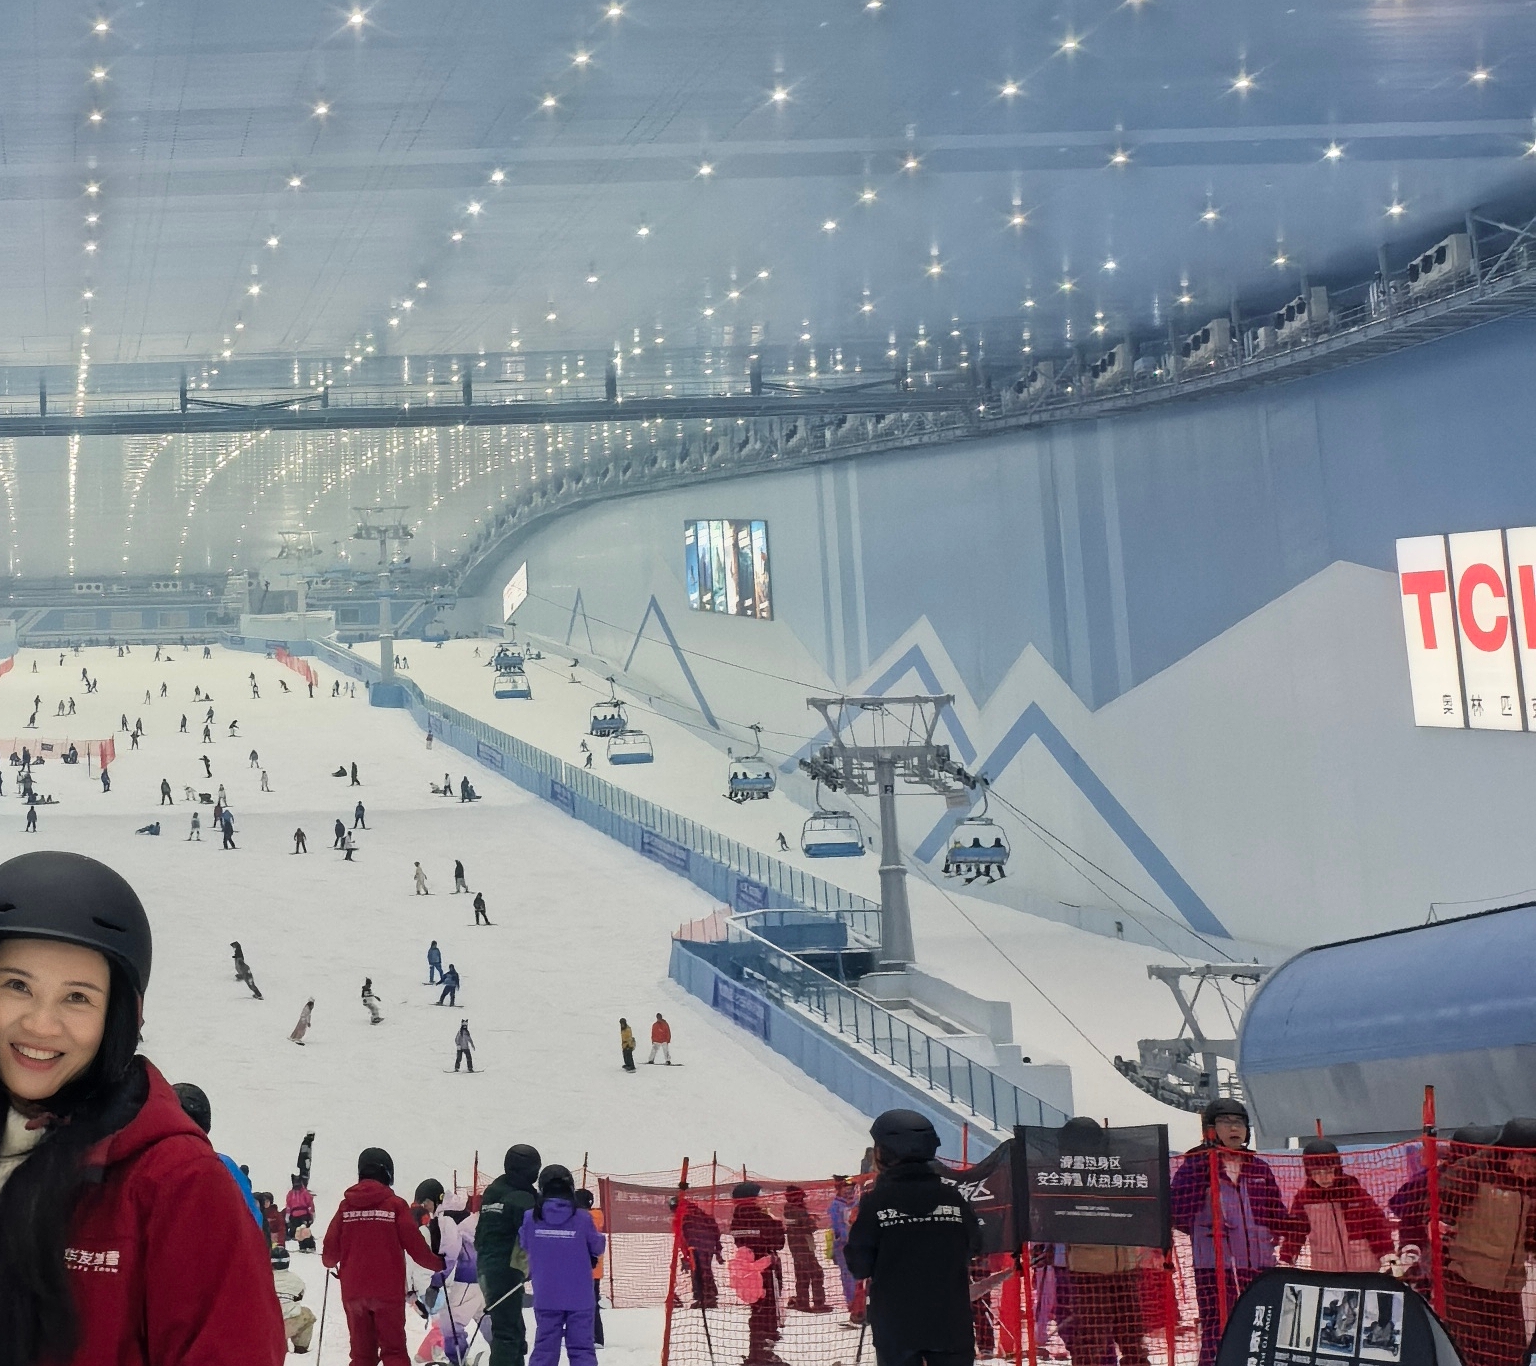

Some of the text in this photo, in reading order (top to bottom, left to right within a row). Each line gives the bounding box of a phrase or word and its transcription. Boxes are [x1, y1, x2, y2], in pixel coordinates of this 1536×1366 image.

[1086, 1173, 1149, 1188] 从热身开始
